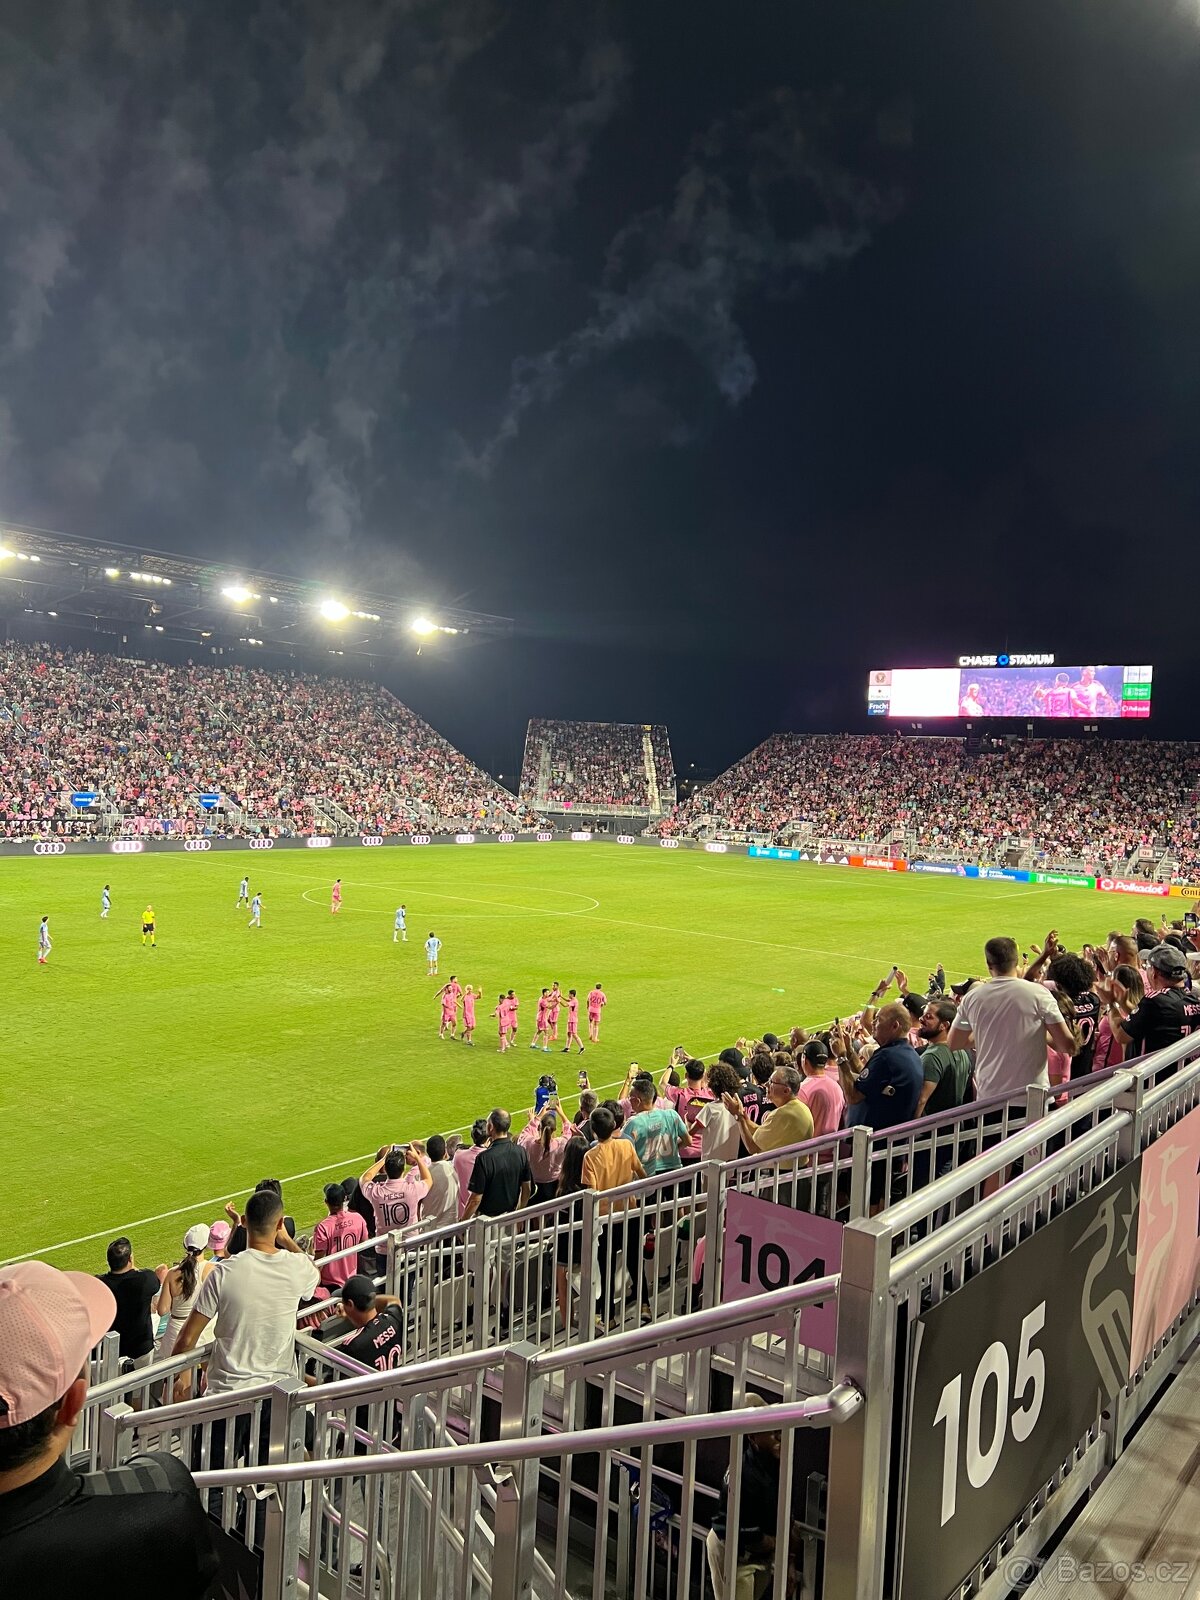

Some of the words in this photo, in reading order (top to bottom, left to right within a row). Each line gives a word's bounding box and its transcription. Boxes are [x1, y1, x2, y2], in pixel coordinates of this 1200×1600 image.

[959, 655, 997, 666] CHASE
[1009, 654, 1055, 665] STADIUM
[1115, 882, 1164, 893] Polkadot
[1074, 1003, 1094, 1013] ESSI
[1078, 1016, 1095, 1046] 0
[384, 1192, 405, 1201] MESSI
[380, 1202, 410, 1226] 10
[335, 1220, 354, 1230] MESSI
[334, 1233, 357, 1252] 10
[373, 1325, 396, 1349] MESSI
[375, 1344, 402, 1371] 10
[932, 1300, 1046, 1527] 105
